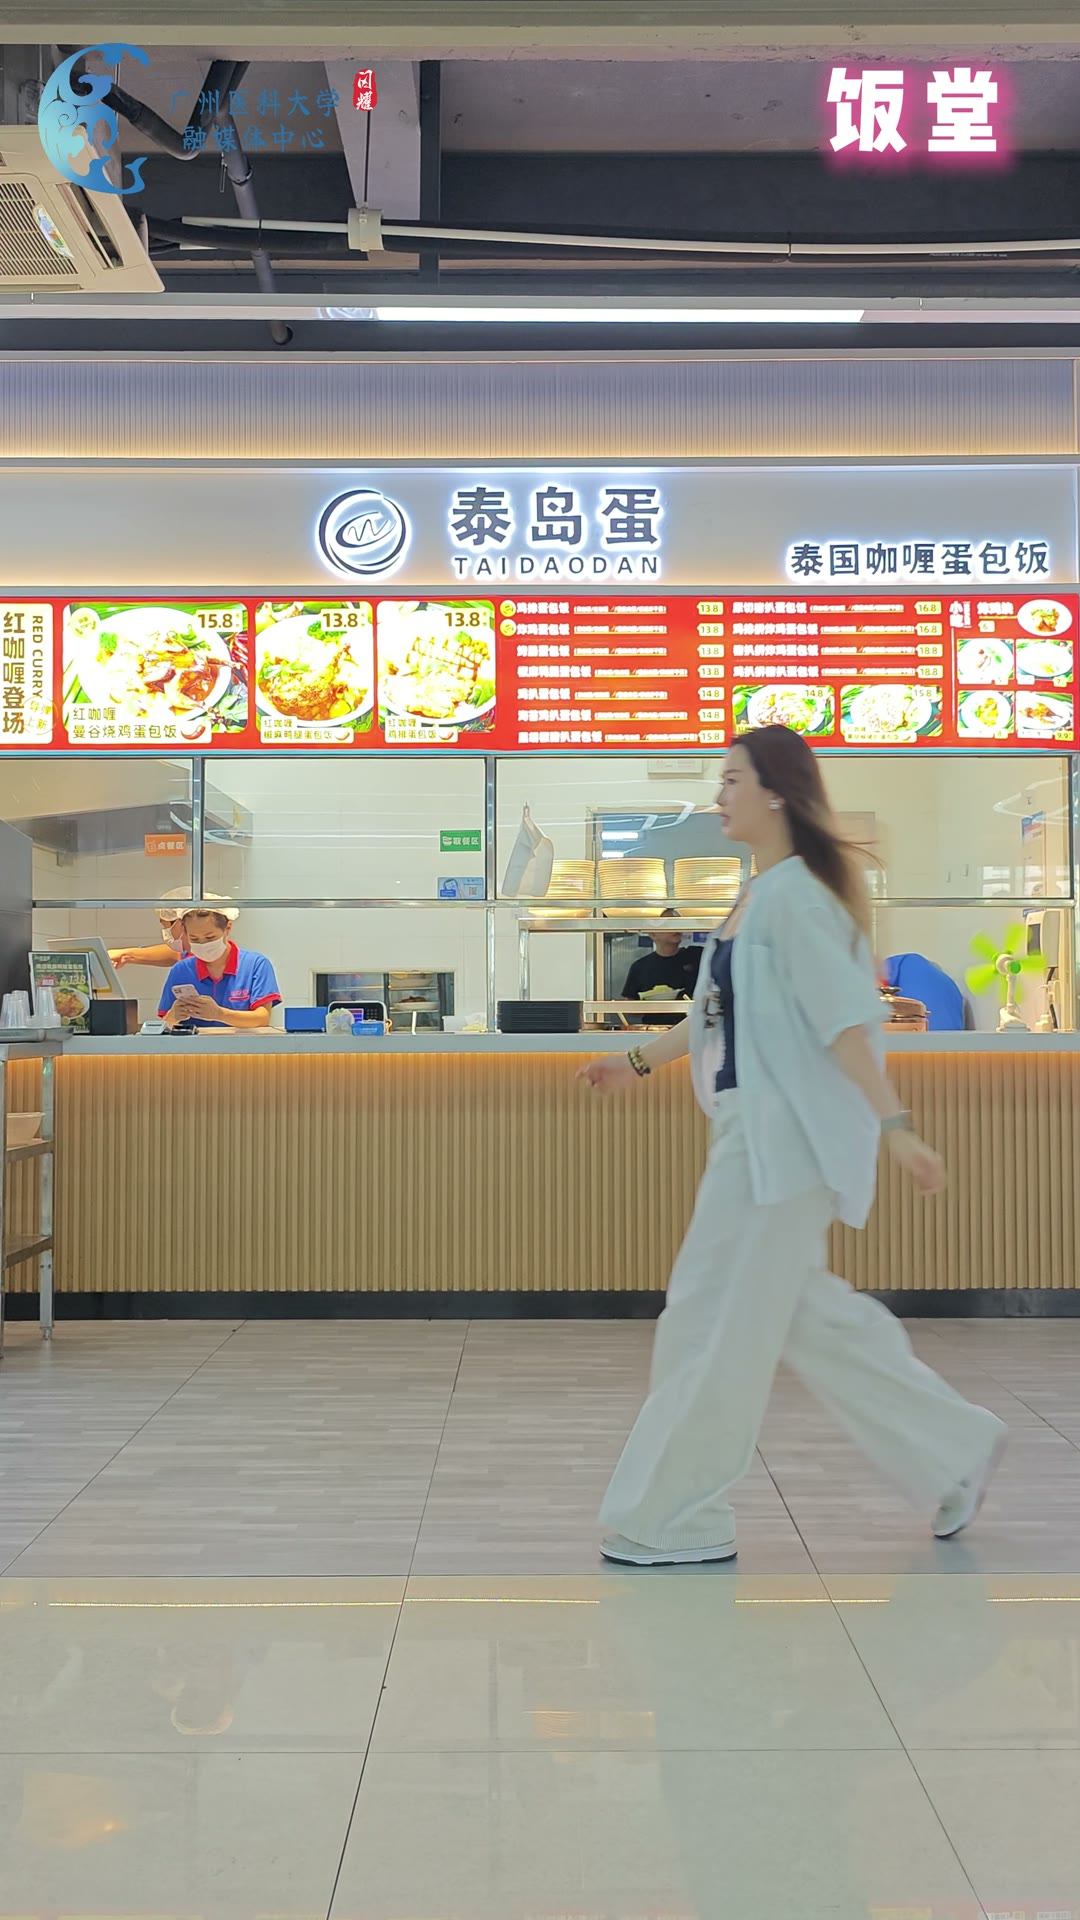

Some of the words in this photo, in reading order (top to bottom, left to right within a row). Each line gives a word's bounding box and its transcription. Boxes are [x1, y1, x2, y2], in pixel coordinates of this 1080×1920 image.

[451, 486, 660, 546] 泰岛蛋
[790, 541, 1050, 576] 泰国咖喱蛋包饭
[454, 556, 658, 575] TAIDAODAN
[701, 604, 719, 613] 13.8
[918, 604, 937, 612] 16.8
[197, 613, 233, 629] 15.8
[322, 613, 359, 628] 13.8
[444, 612, 481, 627] 13.8
[32, 615, 44, 644] RED
[701, 625, 719, 634] 13.8
[919, 625, 938, 634] 16.8
[702, 647, 720, 655] 13.8
[920, 646, 938, 655] 18.8
[2, 611, 26, 735] 红咖喱登场
[32, 649, 44, 699] CURRY
[702, 667, 720, 676] 13.8
[920, 667, 938, 676] 18.8
[702, 689, 720, 698] 14.8
[804, 689, 824, 698] 14.8
[913, 689, 932, 697] 15.8
[72, 707, 117, 721] 红咖喱
[702, 711, 720, 719] 14.8
[263, 719, 293, 728] 红咖喱
[388, 718, 417, 728] 红咖喱
[72, 725, 177, 739] 曼谷烧鸡蛋包饭
[388, 730, 437, 740] 鸡排蛋包饭
[702, 732, 720, 741] 15.8
[157, 841, 185, 850] 点餐区
